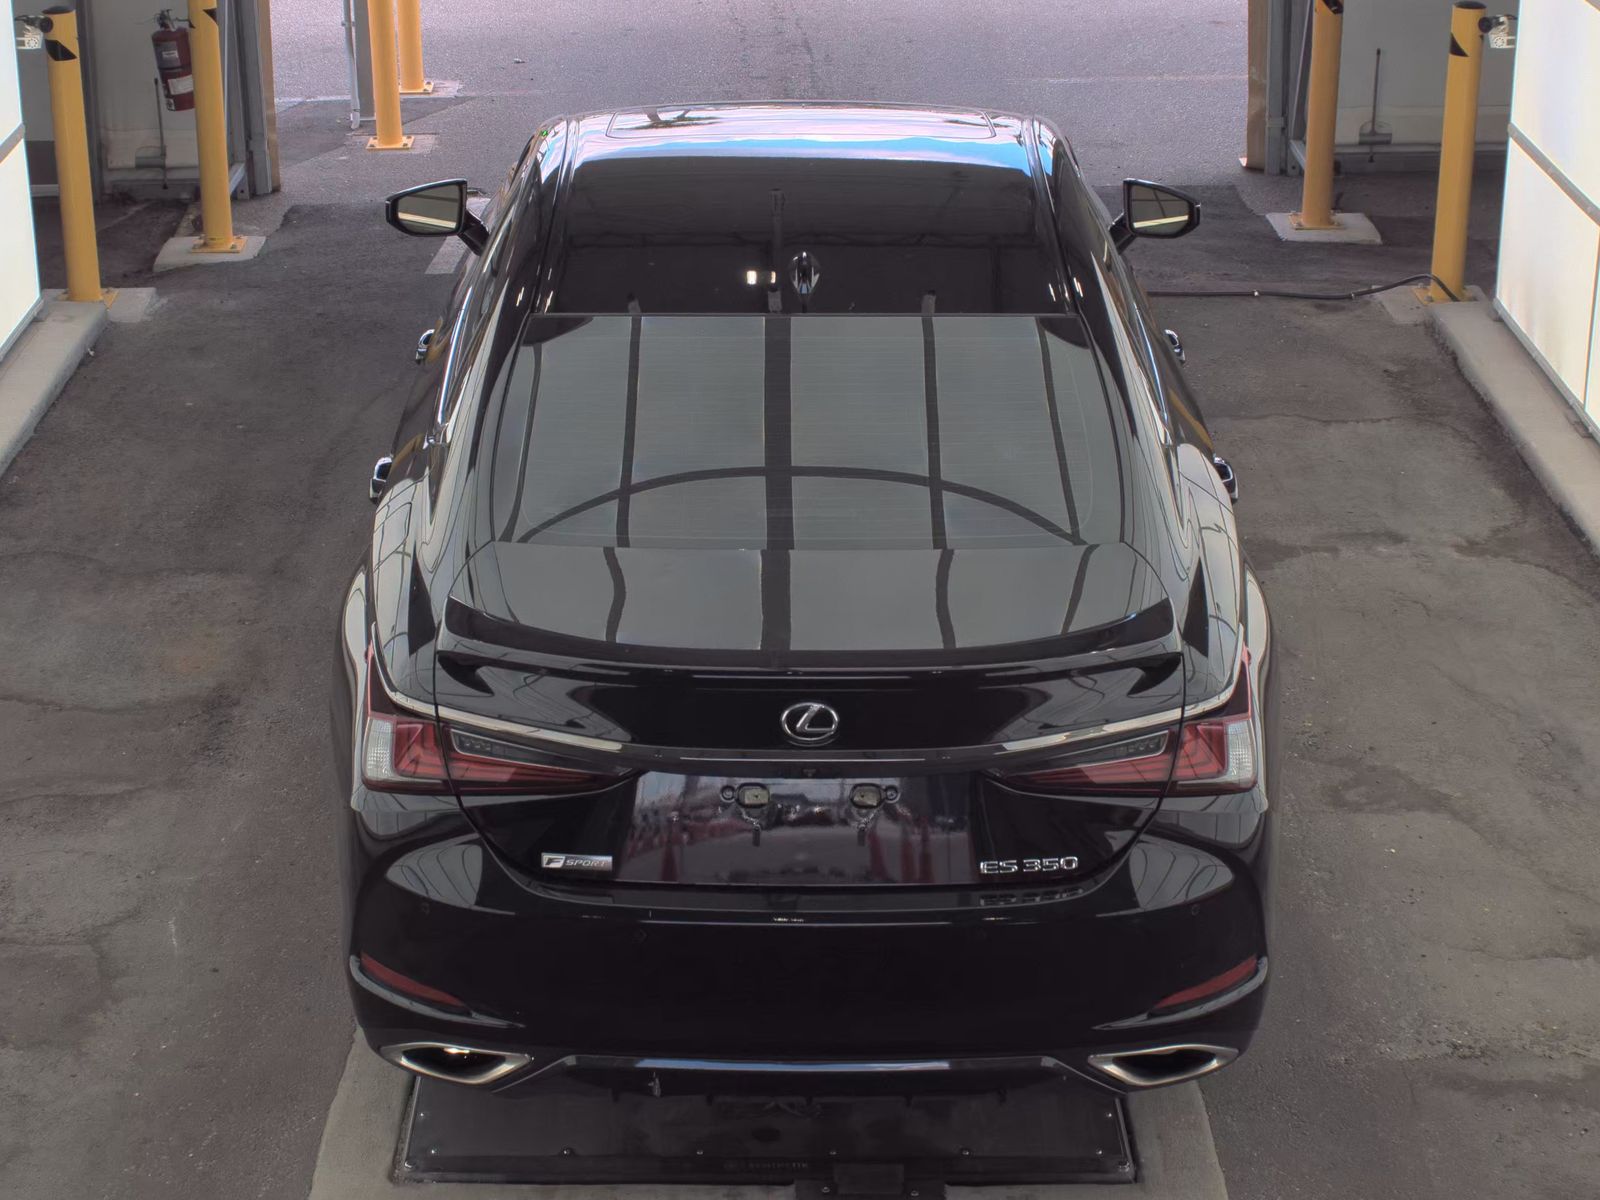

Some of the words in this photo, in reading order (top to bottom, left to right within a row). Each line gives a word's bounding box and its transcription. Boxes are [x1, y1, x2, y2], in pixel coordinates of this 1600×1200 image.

[544, 856, 565, 867] F
[566, 859, 607, 867] SPORT
[980, 859, 1018, 874] ES
[1023, 856, 1078, 872] 350
